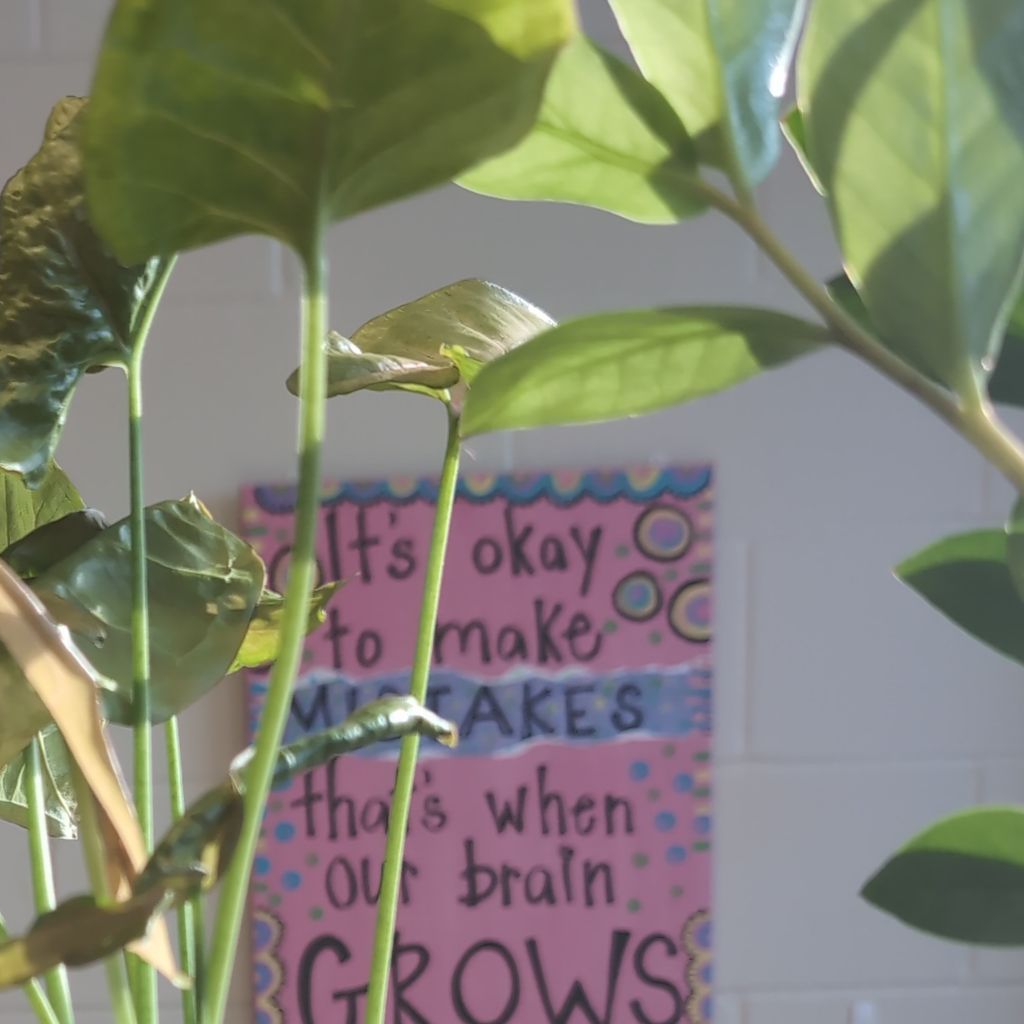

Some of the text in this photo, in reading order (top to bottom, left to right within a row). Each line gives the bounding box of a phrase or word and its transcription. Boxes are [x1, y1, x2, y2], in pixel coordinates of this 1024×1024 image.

[325, 500, 603, 596] It's okay
[326, 598, 603, 669] to make
[291, 682, 644, 739] MITAKES
[291, 757, 635, 840] tha's when
[326, 839, 616, 909] our brain
